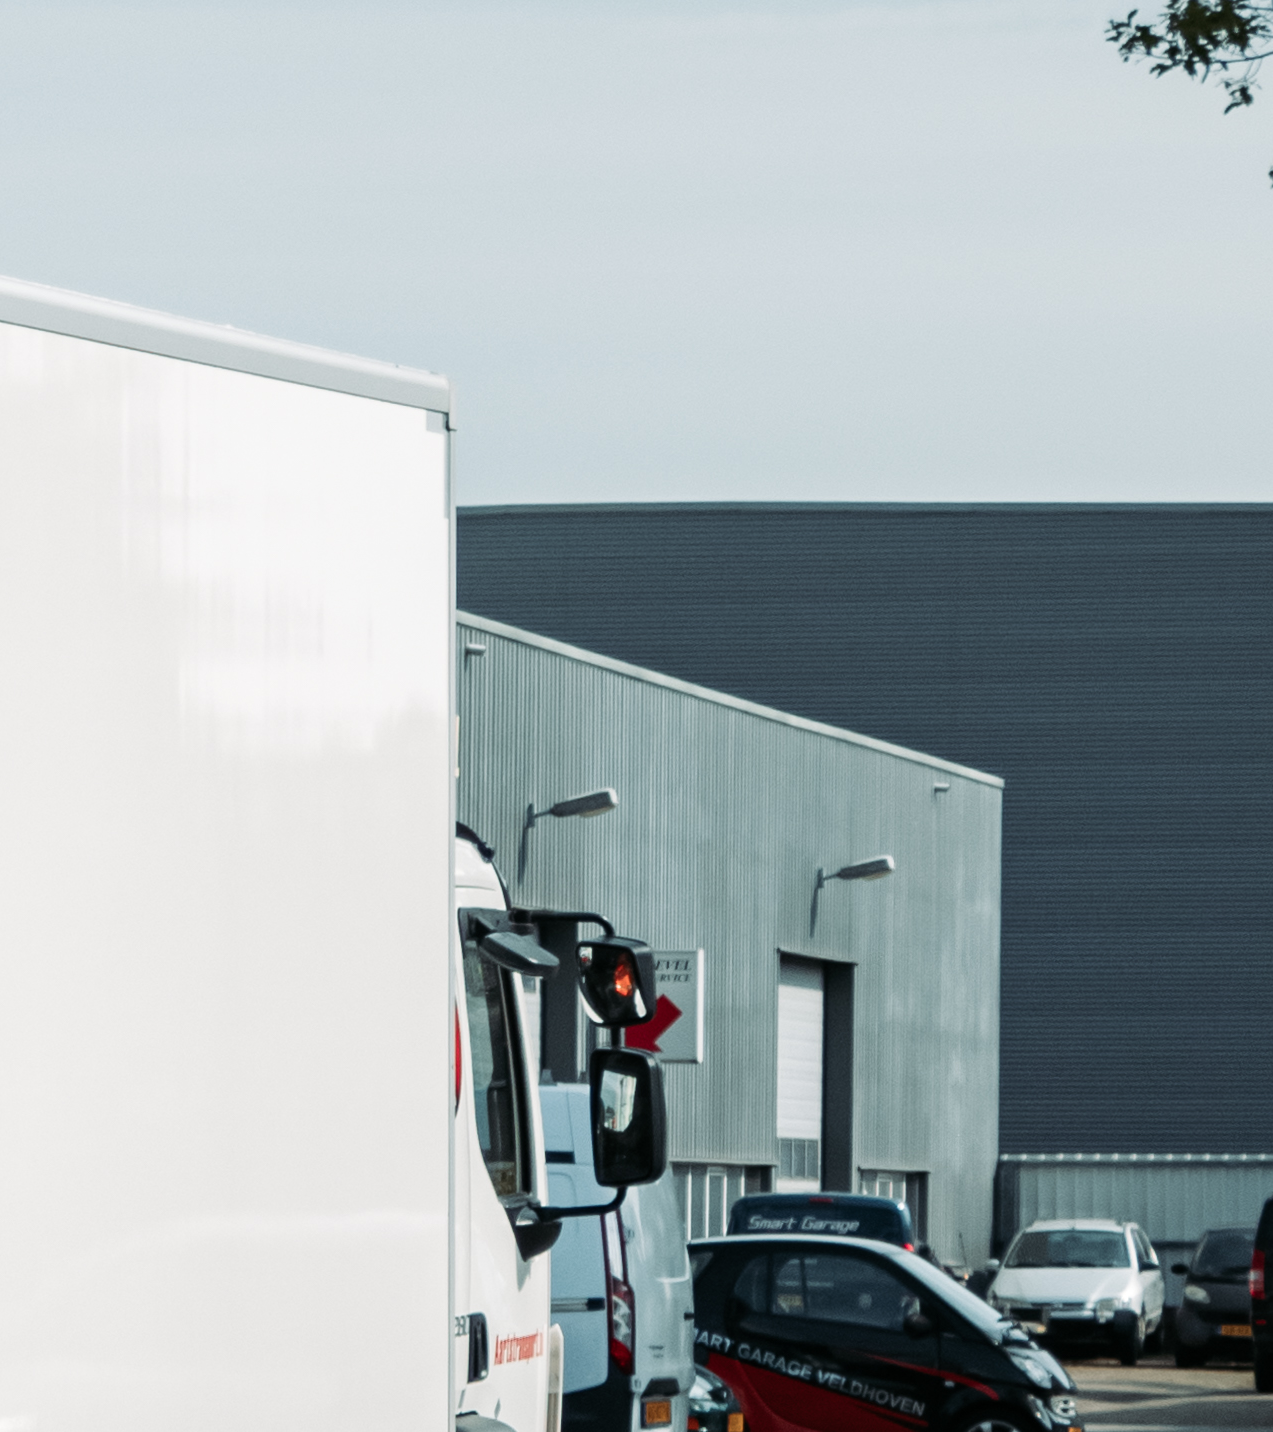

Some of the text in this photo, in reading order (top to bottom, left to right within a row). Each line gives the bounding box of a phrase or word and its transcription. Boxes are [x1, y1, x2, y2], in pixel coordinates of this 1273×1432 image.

[748, 1214, 860, 1234] Smart Garage
[738, 1343, 812, 1380] GARAGE
[817, 1369, 926, 1417] VELDHOVEN
